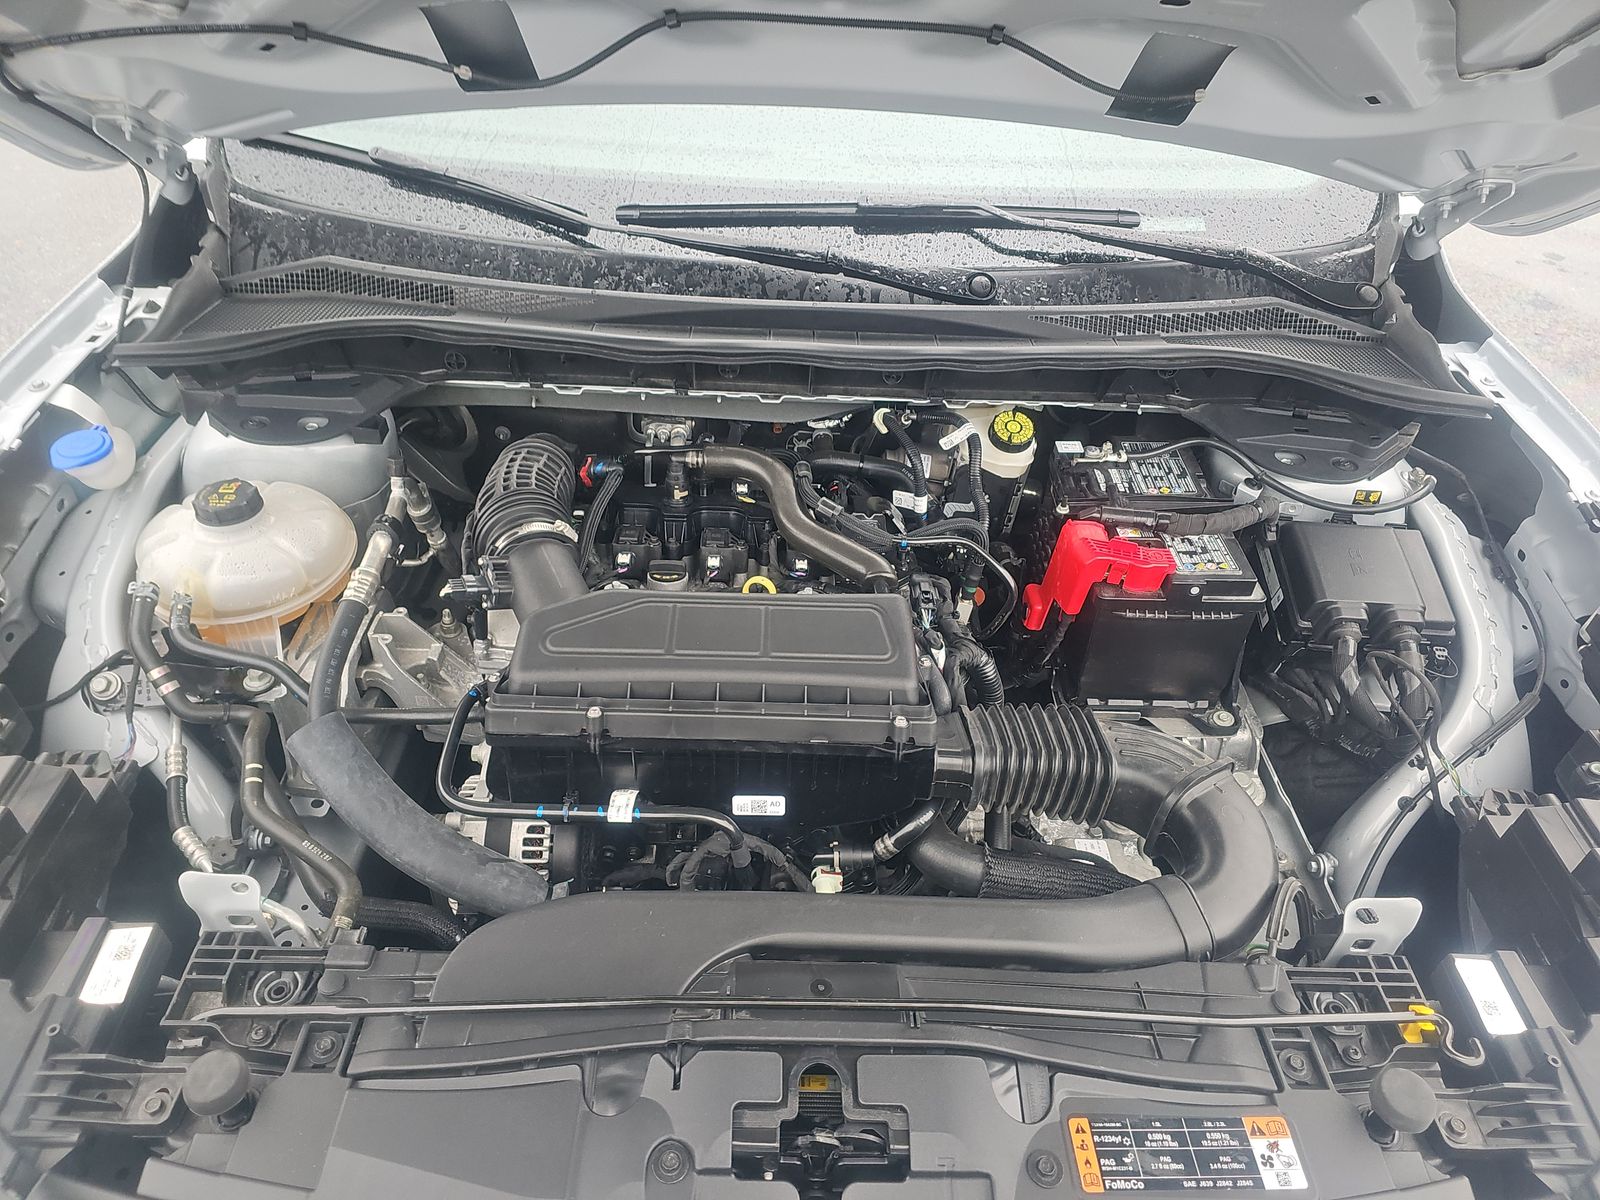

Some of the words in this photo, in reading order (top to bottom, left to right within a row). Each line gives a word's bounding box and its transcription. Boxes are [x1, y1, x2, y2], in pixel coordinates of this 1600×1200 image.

[1093, 1134, 1122, 1144] R-1234yf
[1162, 1133, 1172, 1142] kg
[1221, 1132, 1230, 1140] kg
[1104, 1179, 1145, 1190] FoMoCo
